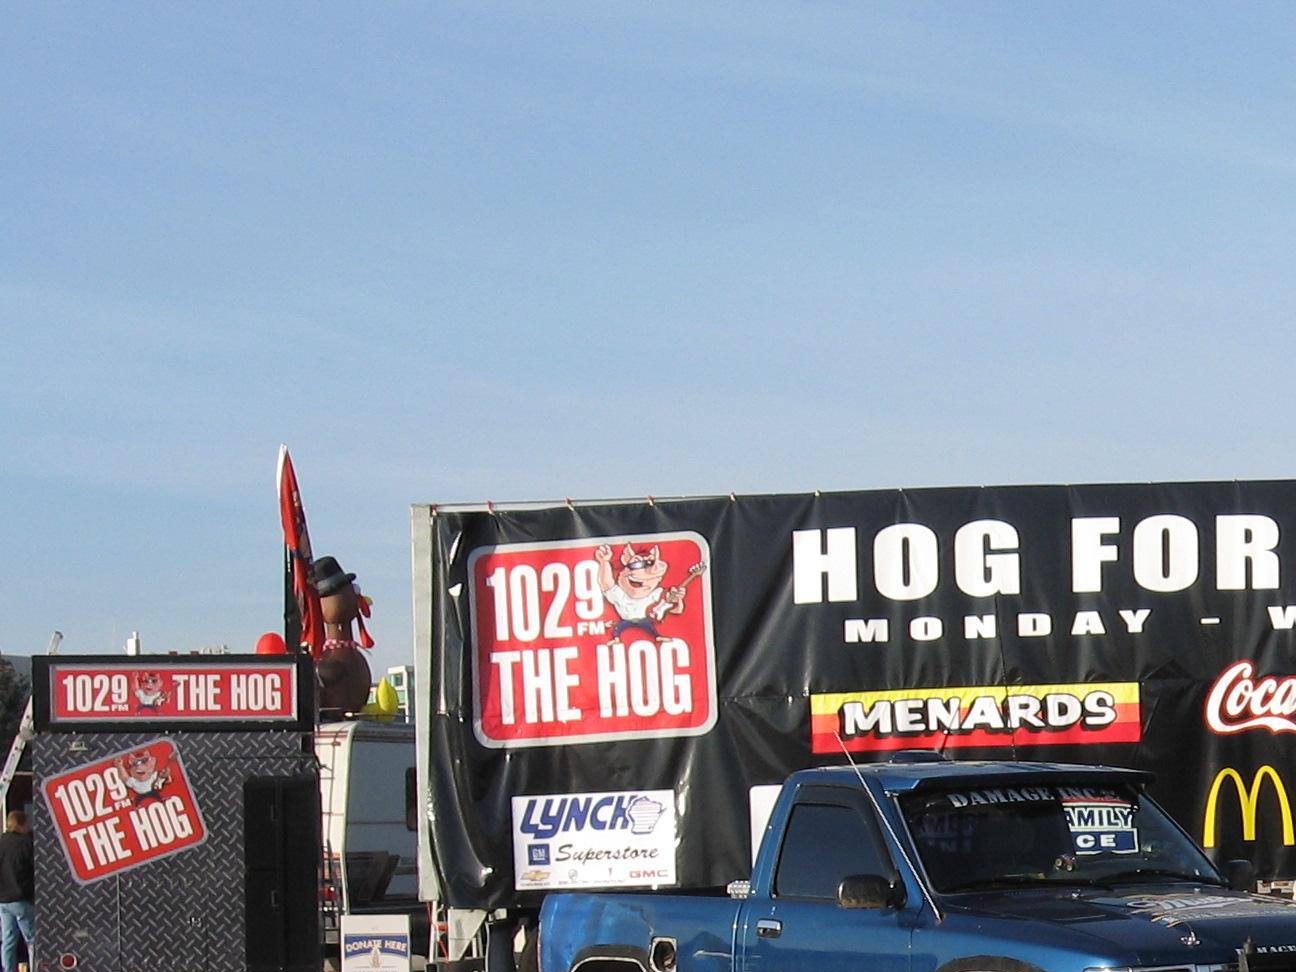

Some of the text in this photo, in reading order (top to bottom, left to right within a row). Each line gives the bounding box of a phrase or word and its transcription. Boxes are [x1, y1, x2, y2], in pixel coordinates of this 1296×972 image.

[793, 519, 1020, 605] HOG
[1071, 513, 1280, 592] FOR
[486, 560, 605, 641] 1029 FM
[844, 608, 1151, 643] MONDAY
[63, 675, 128, 712] 1029
[172, 674, 221, 710] THE
[230, 673, 281, 711] HOG
[490, 638, 693, 725] THE HOG
[842, 690, 1118, 736] MENARDS
[54, 767, 132, 826] 1029 FM
[520, 794, 638, 839] LYNCH
[947, 786, 1055, 808] DAMAGE
[1057, 785, 1100, 801] INC
[70, 796, 194, 871] THE HOG
[555, 844, 658, 865] Superstore
[629, 869, 669, 878] GMC
[346, 940, 408, 953] DONATE HERE
